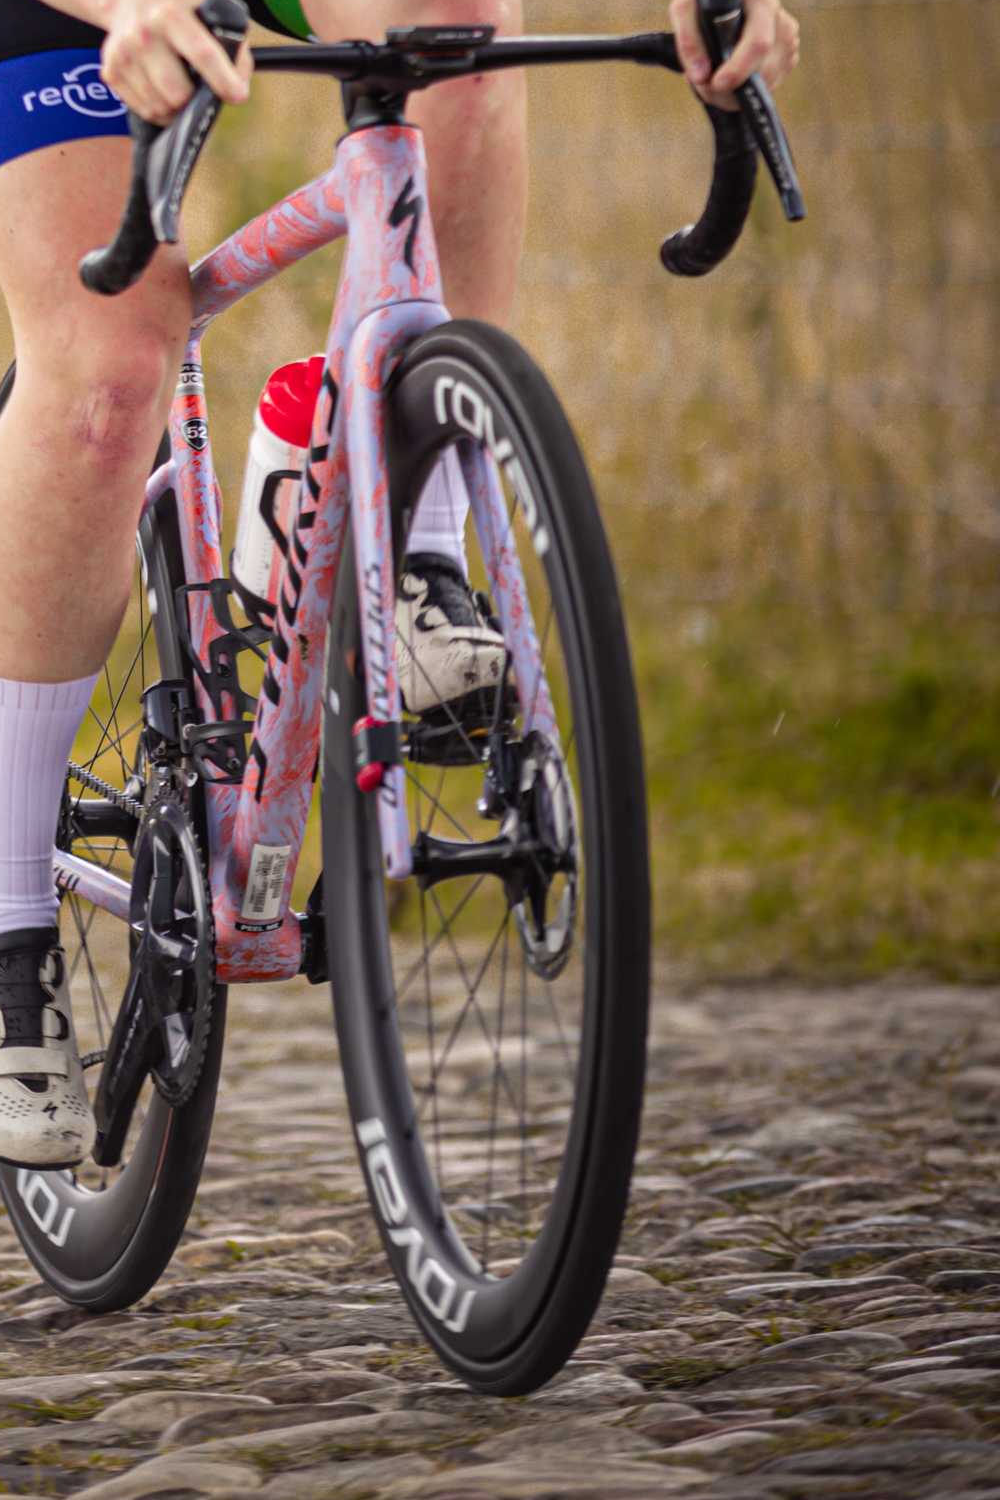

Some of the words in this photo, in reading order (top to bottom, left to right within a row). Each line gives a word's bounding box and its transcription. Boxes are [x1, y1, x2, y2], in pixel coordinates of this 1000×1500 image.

[187, 426, 207, 439] 52
[240, 924, 264, 932] PEEL
[356, 1117, 477, 1333] roval
